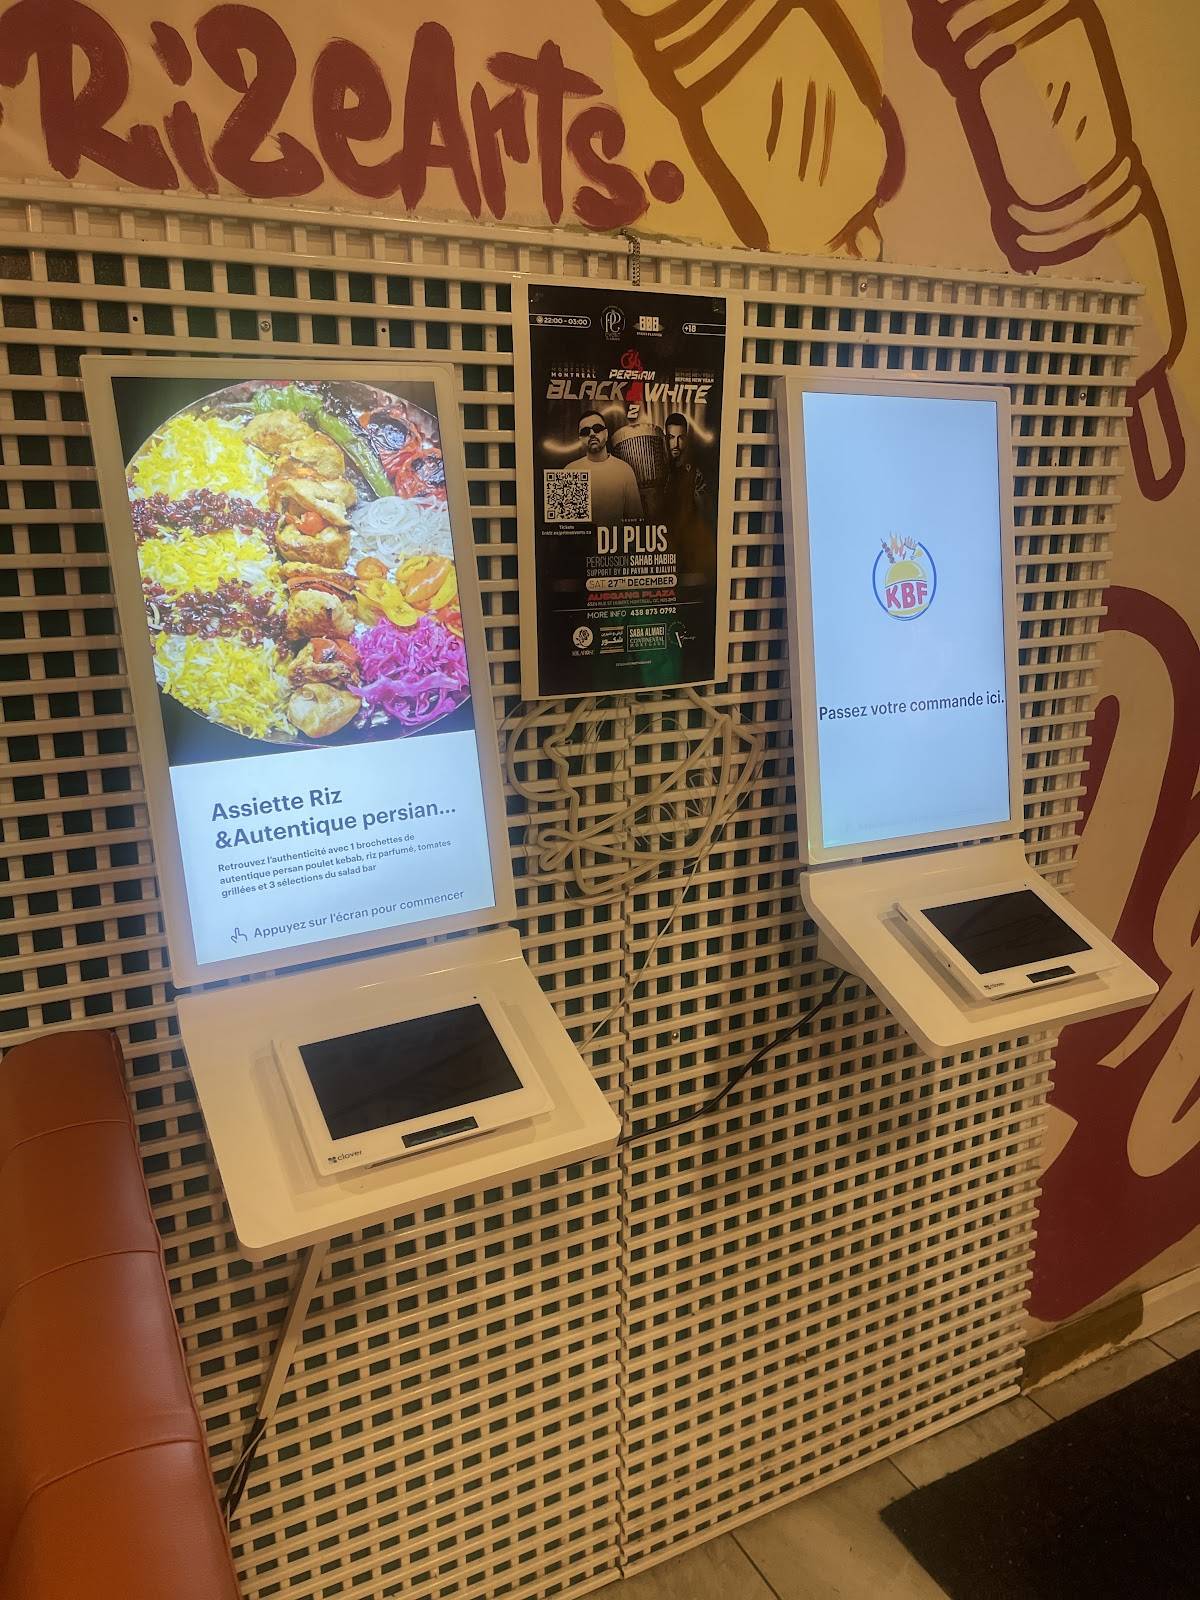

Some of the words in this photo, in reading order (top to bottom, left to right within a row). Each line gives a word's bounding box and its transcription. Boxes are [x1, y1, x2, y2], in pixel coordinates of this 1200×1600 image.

[543, 316, 563, 325] 22:00
[568, 318, 588, 326] 03:00
[684, 324, 697, 333] +18
[551, 371, 597, 379] MONTREAL
[609, 368, 656, 381] PERSIAN
[546, 379, 630, 401] BLACK
[644, 382, 712, 404] WHITE
[626, 404, 640, 419] 2
[596, 525, 618, 554] DJ
[623, 524, 668, 553] PLUS
[586, 555, 629, 568] PERCUSSION
[630, 554, 653, 566] SAHAB
[654, 553, 677, 565] HABIBI
[586, 567, 612, 577] SUPPORT
[613, 567, 620, 576] BY
[622, 567, 629, 575] DJ
[589, 580, 605, 590] SAT
[627, 576, 674, 587] DECEMBER
[885, 581, 928, 609] KBF
[587, 611, 609, 619] MORE
[610, 609, 627, 618] INFO
[630, 608, 644, 617] 438
[645, 608, 658, 616] 873
[659, 606, 677, 615] 0792
[629, 628, 644, 638] SABA
[819, 704, 868, 721] Passez
[871, 700, 907, 716] votre
[909, 691, 983, 712] commande
[985, 689, 1004, 706] ici.
[211, 794, 304, 822] Assiette
[309, 787, 343, 808] Riz
[215, 816, 357, 849] &Autentique
[362, 800, 456, 830] persian...
[217, 857, 266, 873] Retrouvez
[267, 847, 327, 865] l'authenticité
[328, 844, 349, 855] avec
[350, 843, 355, 852] 1
[356, 836, 399, 850] brochettes
[401, 833, 415, 842] de
[219, 871, 271, 886] autentique
[272, 864, 304, 878] persan
[305, 858, 334, 874] poulet
[335, 852, 364, 867] kebab,
[366, 850, 377, 860] riz
[378, 845, 417, 860] parfumé,
[417, 840, 451, 854] tomates
[221, 883, 256, 899] grillées
[257, 882, 268, 891] et
[268, 880, 276, 890] 3
[276, 873, 324, 888] sélections
[324, 870, 337, 880] du
[337, 865, 361, 879] salad
[362, 863, 377, 874] bar
[253, 921, 307, 940] Appuyez
[308, 916, 327, 929] sur
[329, 908, 369, 925] l'écran
[371, 903, 397, 919] pour
[399, 889, 465, 912] commencer
[337, 1150, 363, 1161] clover
